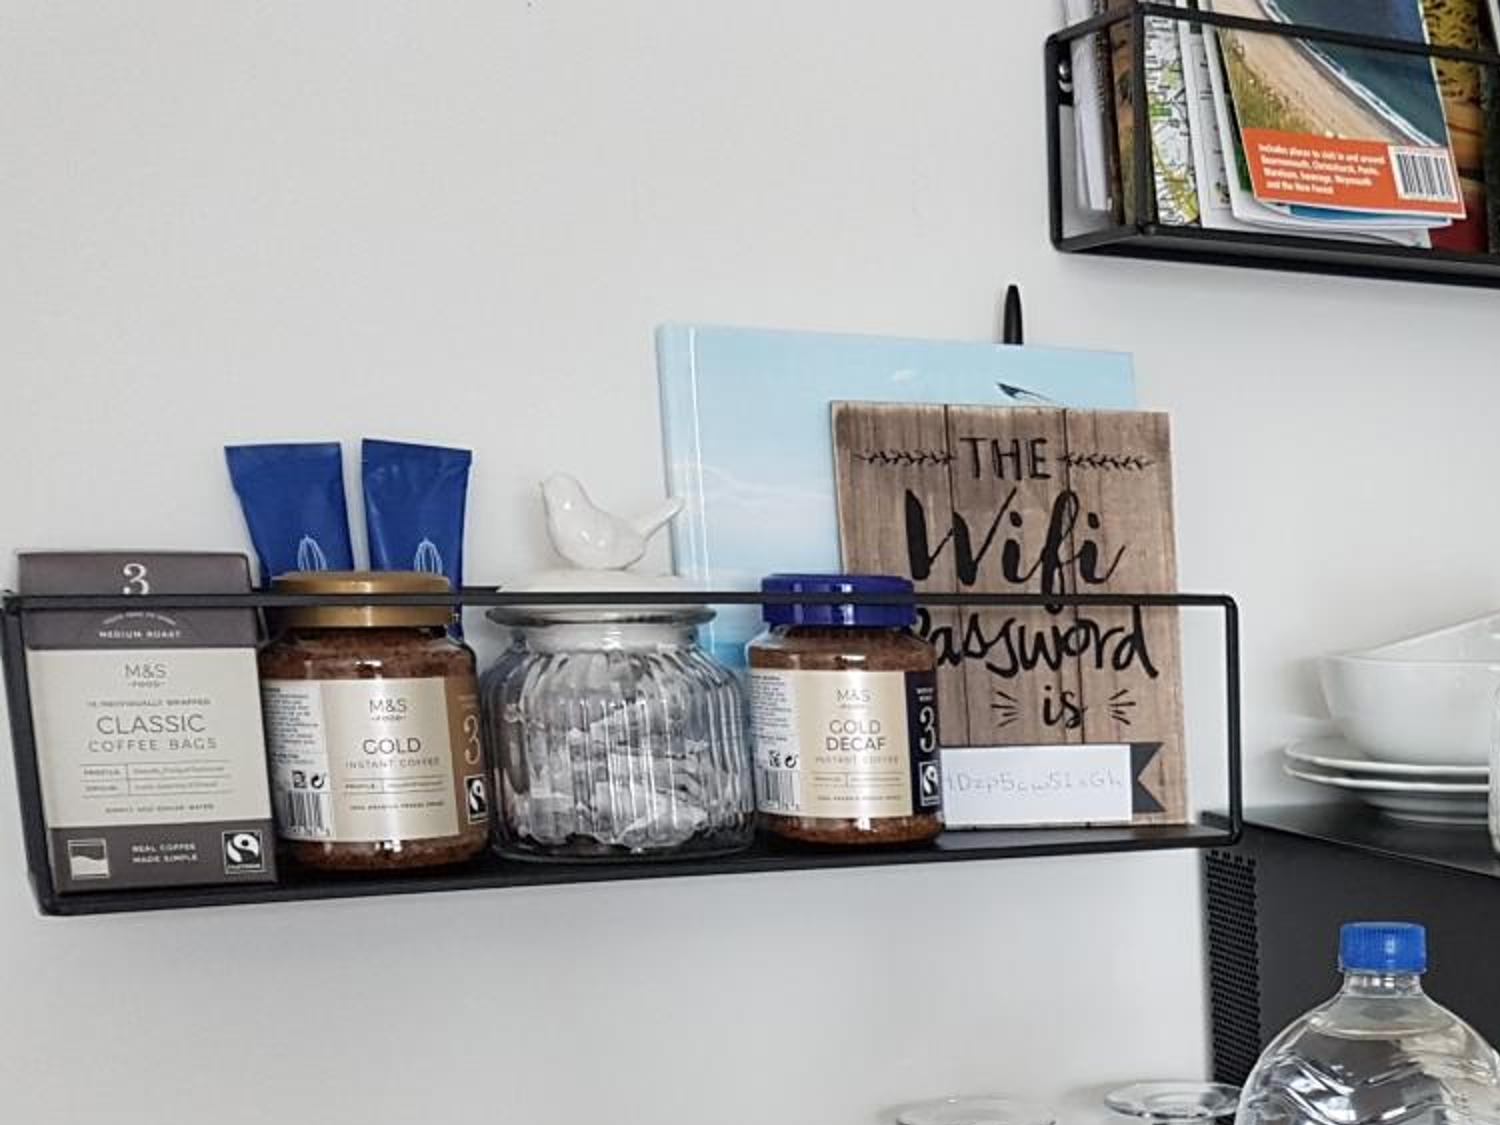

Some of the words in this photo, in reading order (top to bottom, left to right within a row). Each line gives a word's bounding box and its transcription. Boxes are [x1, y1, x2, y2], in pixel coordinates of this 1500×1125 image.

[959, 437, 1053, 481] THE
[904, 488, 1126, 614] Wifi
[122, 563, 150, 596] 3
[98, 630, 142, 639] MEDIUM
[146, 630, 182, 639] ROAST
[124, 663, 167, 679] M&S
[369, 699, 408, 713] M&S
[1042, 686, 1087, 730] is
[97, 714, 207, 736] CLASSIC
[829, 719, 882, 735] GOLD
[919, 706, 936, 753] 3
[88, 740, 159, 753] COFFEE
[168, 737, 218, 751] BAGS
[362, 737, 422, 755] GOLD
[463, 715, 481, 765] 3
[826, 736, 888, 751] DECAF
[345, 759, 396, 769] INSTANT
[399, 757, 441, 768] COFFEE
[131, 844, 156, 854] REAL
[160, 842, 196, 853] COFFEE
[132, 855, 160, 864] MADE
[163, 853, 198, 864] SIMPLE
